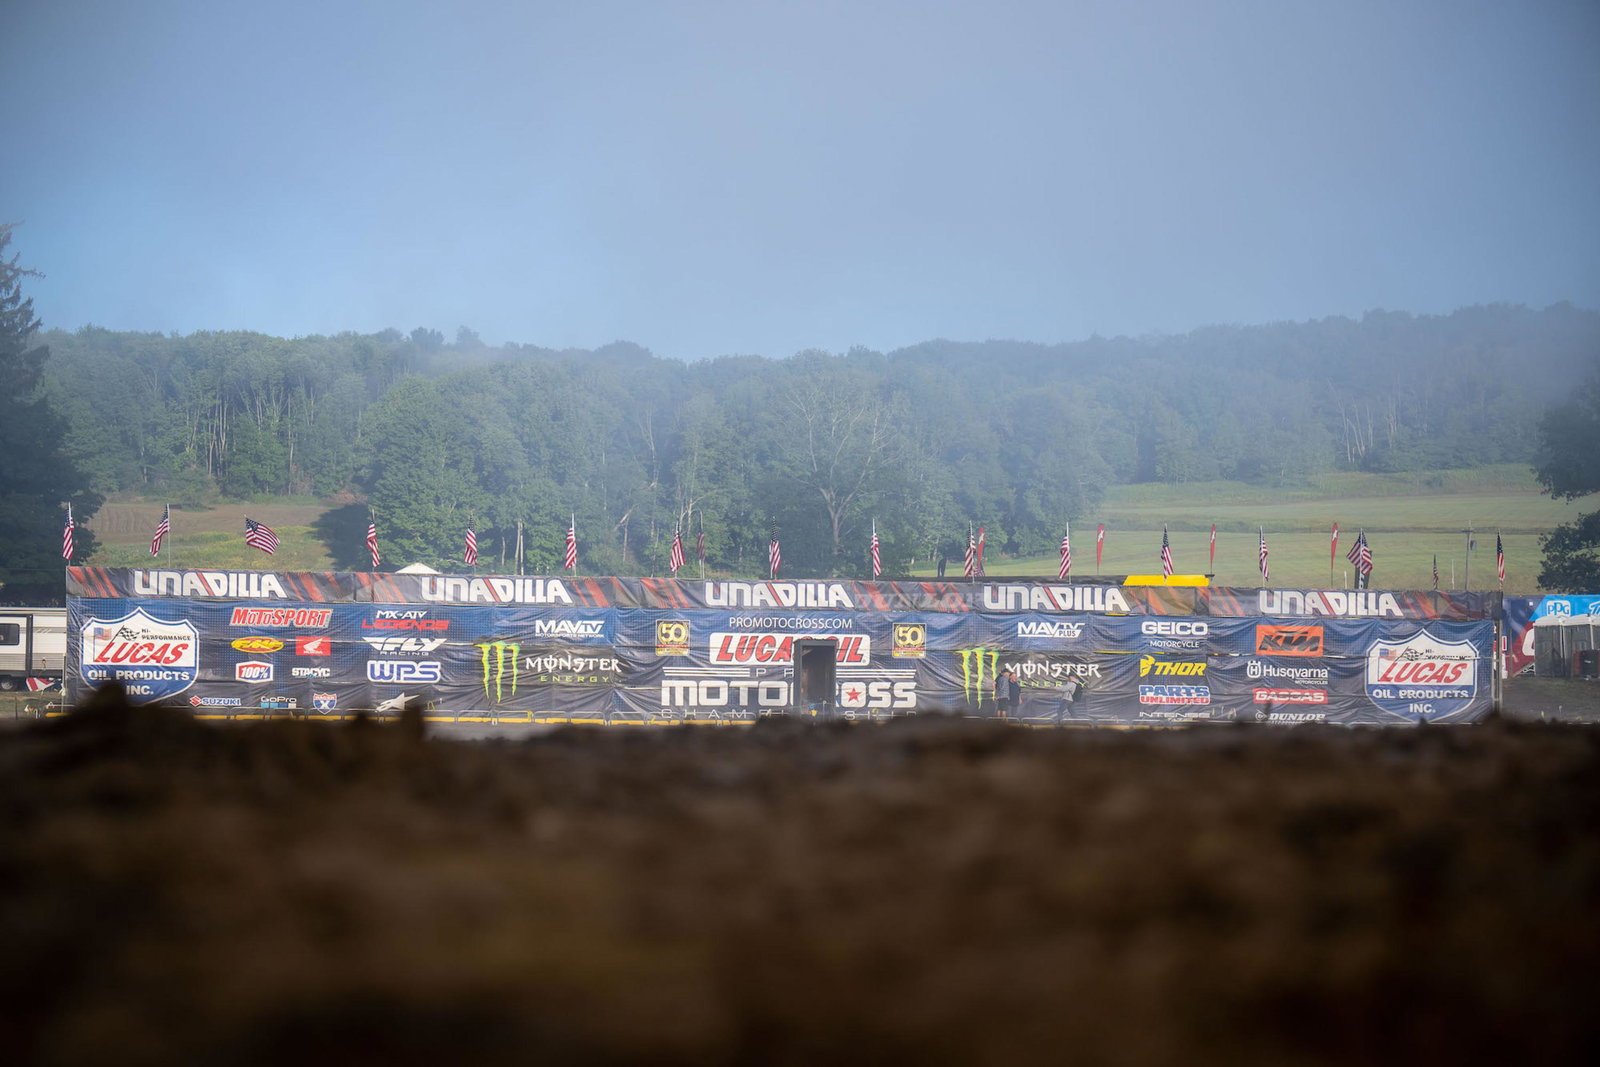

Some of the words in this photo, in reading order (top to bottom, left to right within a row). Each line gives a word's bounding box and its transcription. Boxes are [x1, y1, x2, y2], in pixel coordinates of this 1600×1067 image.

[134, 570, 287, 598] UNADILLA
[421, 576, 573, 604] UNADILLA
[705, 582, 854, 608] UNADILLA
[983, 586, 1131, 612] UNADILLA
[1259, 591, 1404, 617] UNADILLA
[1547, 602, 1570, 616] PPG
[1141, 621, 1209, 636] GEICO
[1149, 640, 1200, 648] MOTORCYCLE
[1258, 630, 1320, 652] KTM
[94, 641, 189, 664] LUCAS
[716, 634, 813, 662] LUCA
[826, 635, 864, 663] IL
[88, 671, 111, 681] OIL
[116, 671, 190, 681] PRODUCTS
[239, 666, 269, 678] 100%
[291, 667, 330, 677] STACYC
[368, 661, 441, 683] WPS
[1154, 663, 1207, 676] THOR
[1263, 664, 1328, 679] Husqvarna
[1377, 662, 1468, 683] LUCAS
[126, 685, 154, 695] INC.
[1139, 685, 1210, 697] PARTS
[1373, 689, 1395, 699] OIL
[1398, 690, 1469, 699] PRODUCTS
[201, 698, 241, 706] SUZUKI
[1140, 696, 1210, 704] UNLIMITED
[1409, 703, 1436, 713] INC.
[1268, 712, 1326, 720] DUNLOP
